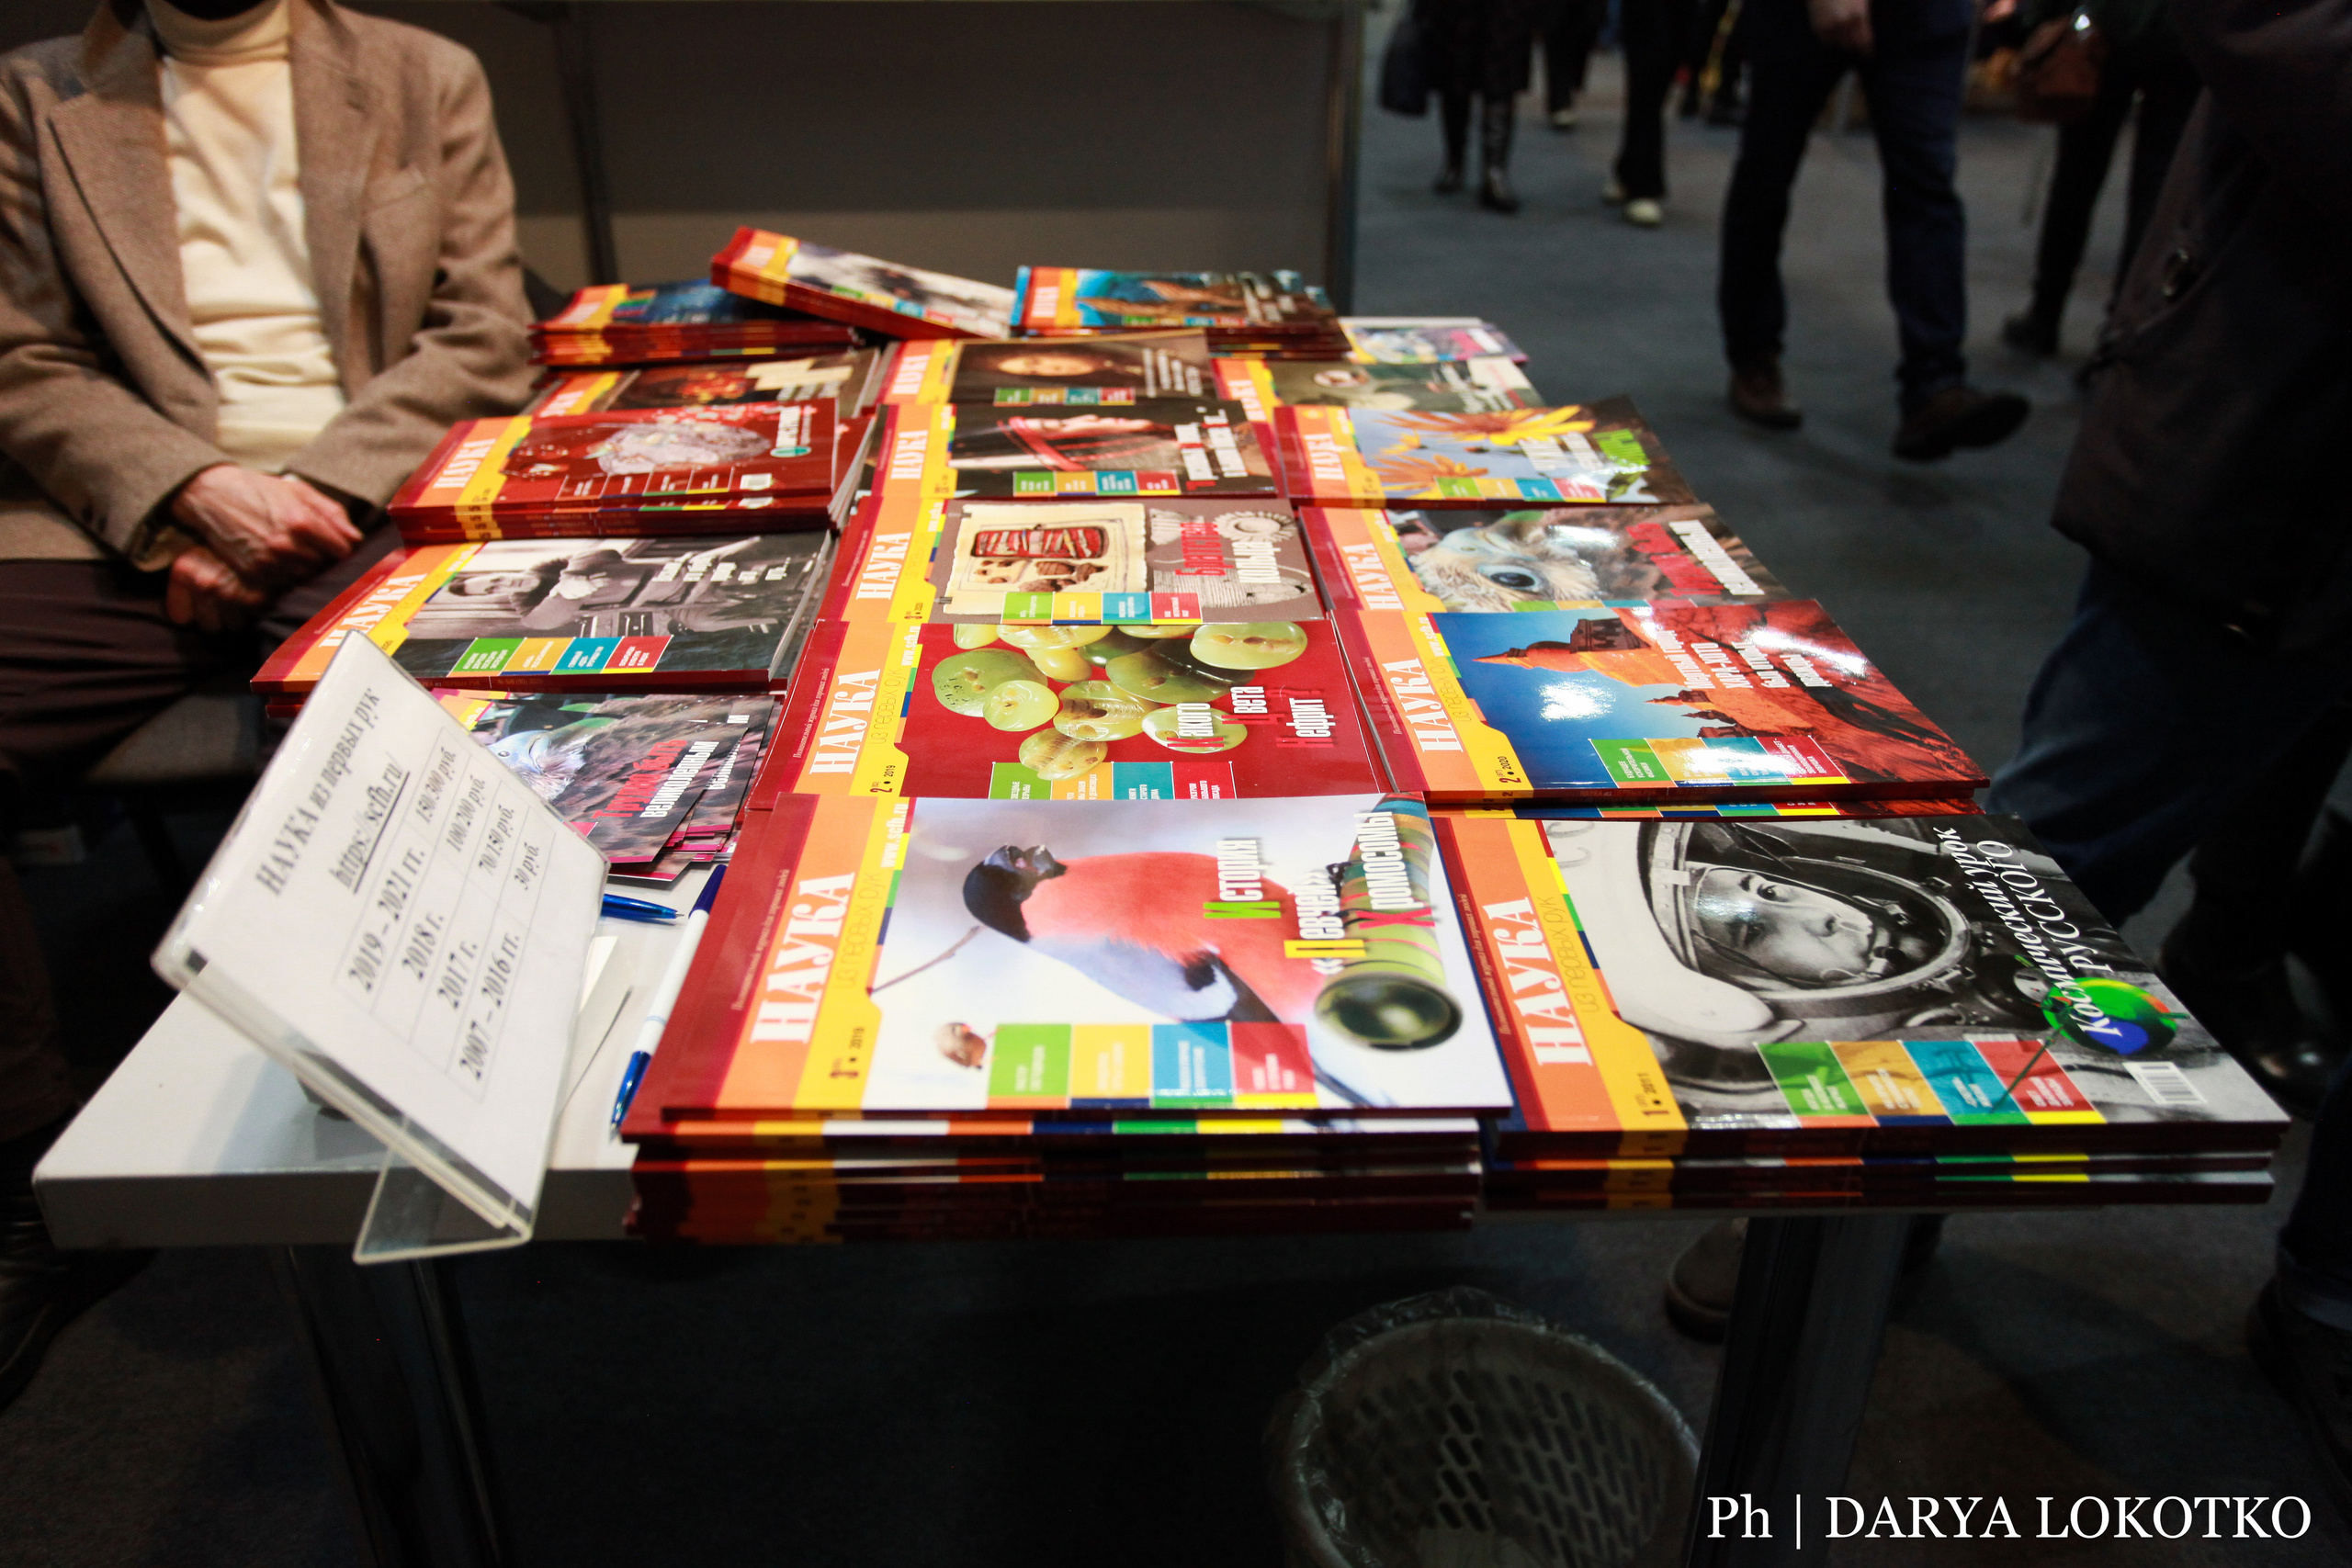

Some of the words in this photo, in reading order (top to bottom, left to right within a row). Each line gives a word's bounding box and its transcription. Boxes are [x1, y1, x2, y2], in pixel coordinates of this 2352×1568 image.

[855, 532, 911, 599] НАУКА
[1231, 541, 1281, 583] кольца
[1341, 543, 1405, 610] НАУКА
[1664, 653, 1717, 689] Мертвый
[1688, 642, 1753, 688] ХАРА-ХОТО
[1728, 640, 1776, 669] открыт
[1750, 671, 1792, 687] был
[1777, 654, 1833, 686] дважды
[808, 669, 881, 774] НАУКА
[869, 731, 889, 743] из
[872, 690, 900, 728] первых
[1166, 703, 1224, 747] Какого
[1221, 685, 1278, 726] Цвета
[1380, 658, 1464, 752] НАУКА
[255, 807, 318, 895] НАУКА
[310, 784, 332, 809] из
[322, 719, 363, 787] первых
[355, 688, 379, 728] рук
[415, 770, 444, 823] 150/300
[439, 747, 456, 780] руб.
[592, 773, 662, 818] Трудно
[632, 739, 688, 770] быть
[639, 741, 719, 818] великолепным
[882, 764, 896, 776] 2019
[1496, 756, 1513, 769] 2020
[447, 799, 474, 852] 100/200
[469, 774, 485, 807] руб.
[479, 829, 504, 874] 70/150
[497, 805, 514, 838] руб.
[878, 803, 910, 866] www.scfh.ru
[514, 869, 530, 890] 30
[522, 842, 539, 875] руб.
[1204, 837, 1281, 919] История
[1353, 811, 1436, 928] Хромосомы
[1934, 827, 1999, 880] урок
[349, 933, 382, 992] 2019
[379, 871, 412, 921] 2021
[402, 848, 424, 874] гг.
[1284, 870, 1367, 975] «Певчей»
[1536, 896, 1567, 922] рук
[1975, 840, 2114, 974] РУССКОГО
[402, 923, 435, 981] 2018
[426, 912, 444, 931] г.
[438, 953, 470, 1010] 2017
[459, 942, 478, 960] г.
[747, 872, 856, 1043] НАУКА
[1550, 929, 1593, 988] первых
[1967, 883, 2122, 1037] Космический
[459, 1021, 492, 1080] 2007
[481, 952, 510, 1009] 2016
[502, 933, 519, 959] гг.
[1482, 897, 1593, 1066] НАУКА
[1575, 992, 1602, 1012] из
